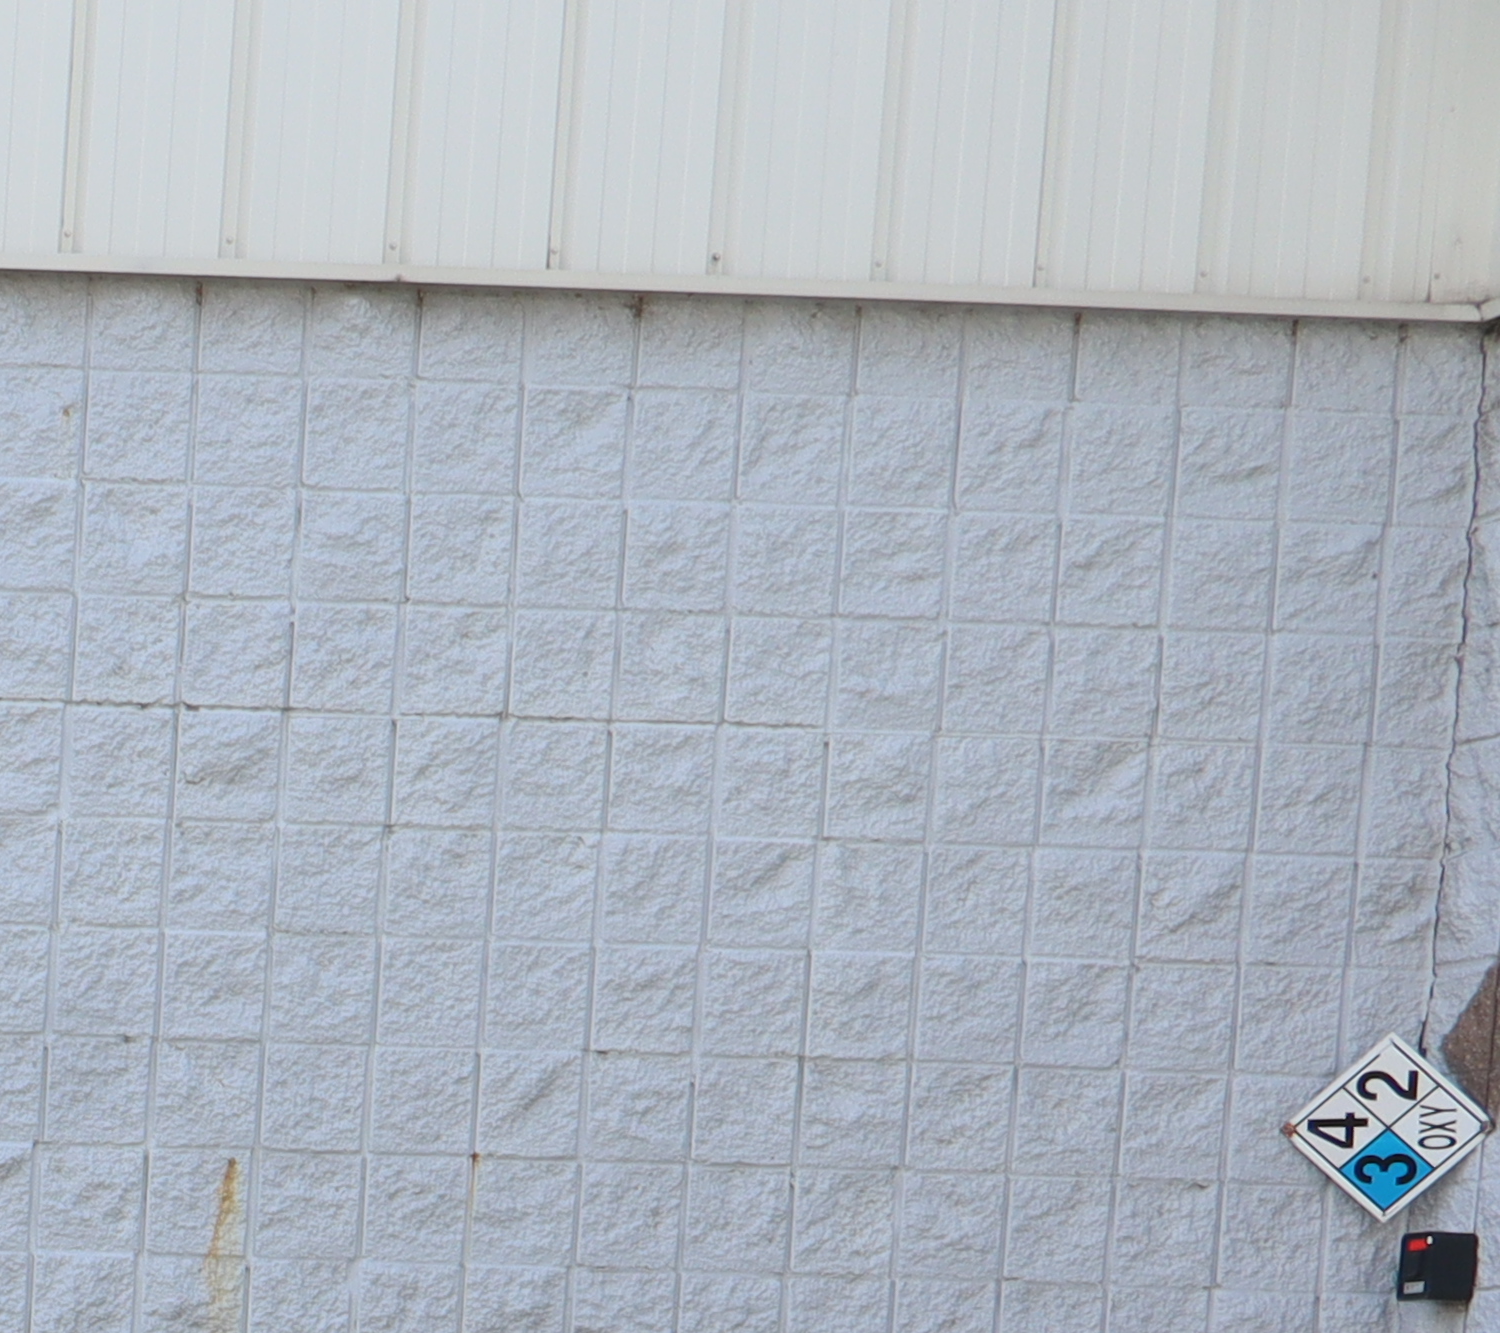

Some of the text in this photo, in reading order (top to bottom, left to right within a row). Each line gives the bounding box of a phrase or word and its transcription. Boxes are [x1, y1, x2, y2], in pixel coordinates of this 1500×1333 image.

[1356, 1070, 1419, 1101] 2
[1306, 1112, 1368, 1149] 4
[1417, 1104, 1457, 1150] OXY
[1353, 1153, 1418, 1185] 3
